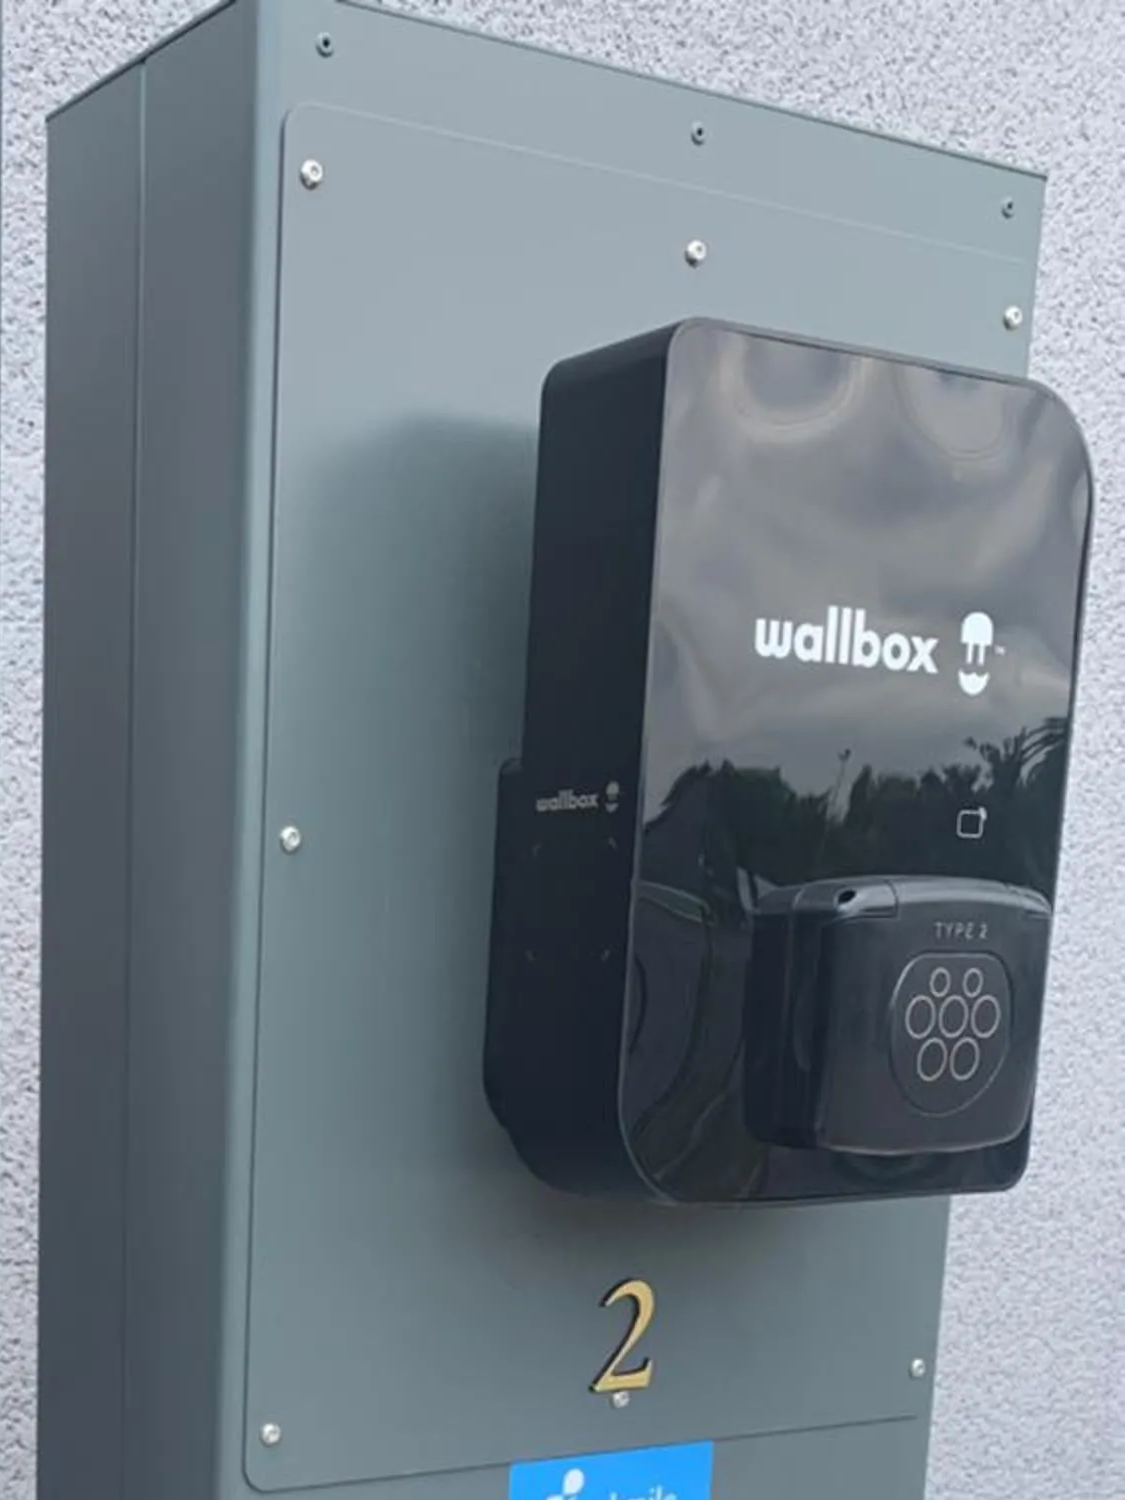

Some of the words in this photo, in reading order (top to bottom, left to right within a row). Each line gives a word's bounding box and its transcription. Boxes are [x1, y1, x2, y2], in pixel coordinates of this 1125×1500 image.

[754, 604, 939, 674] wallbox
[933, 921, 974, 940] TYPE
[589, 1277, 654, 1392] 2
